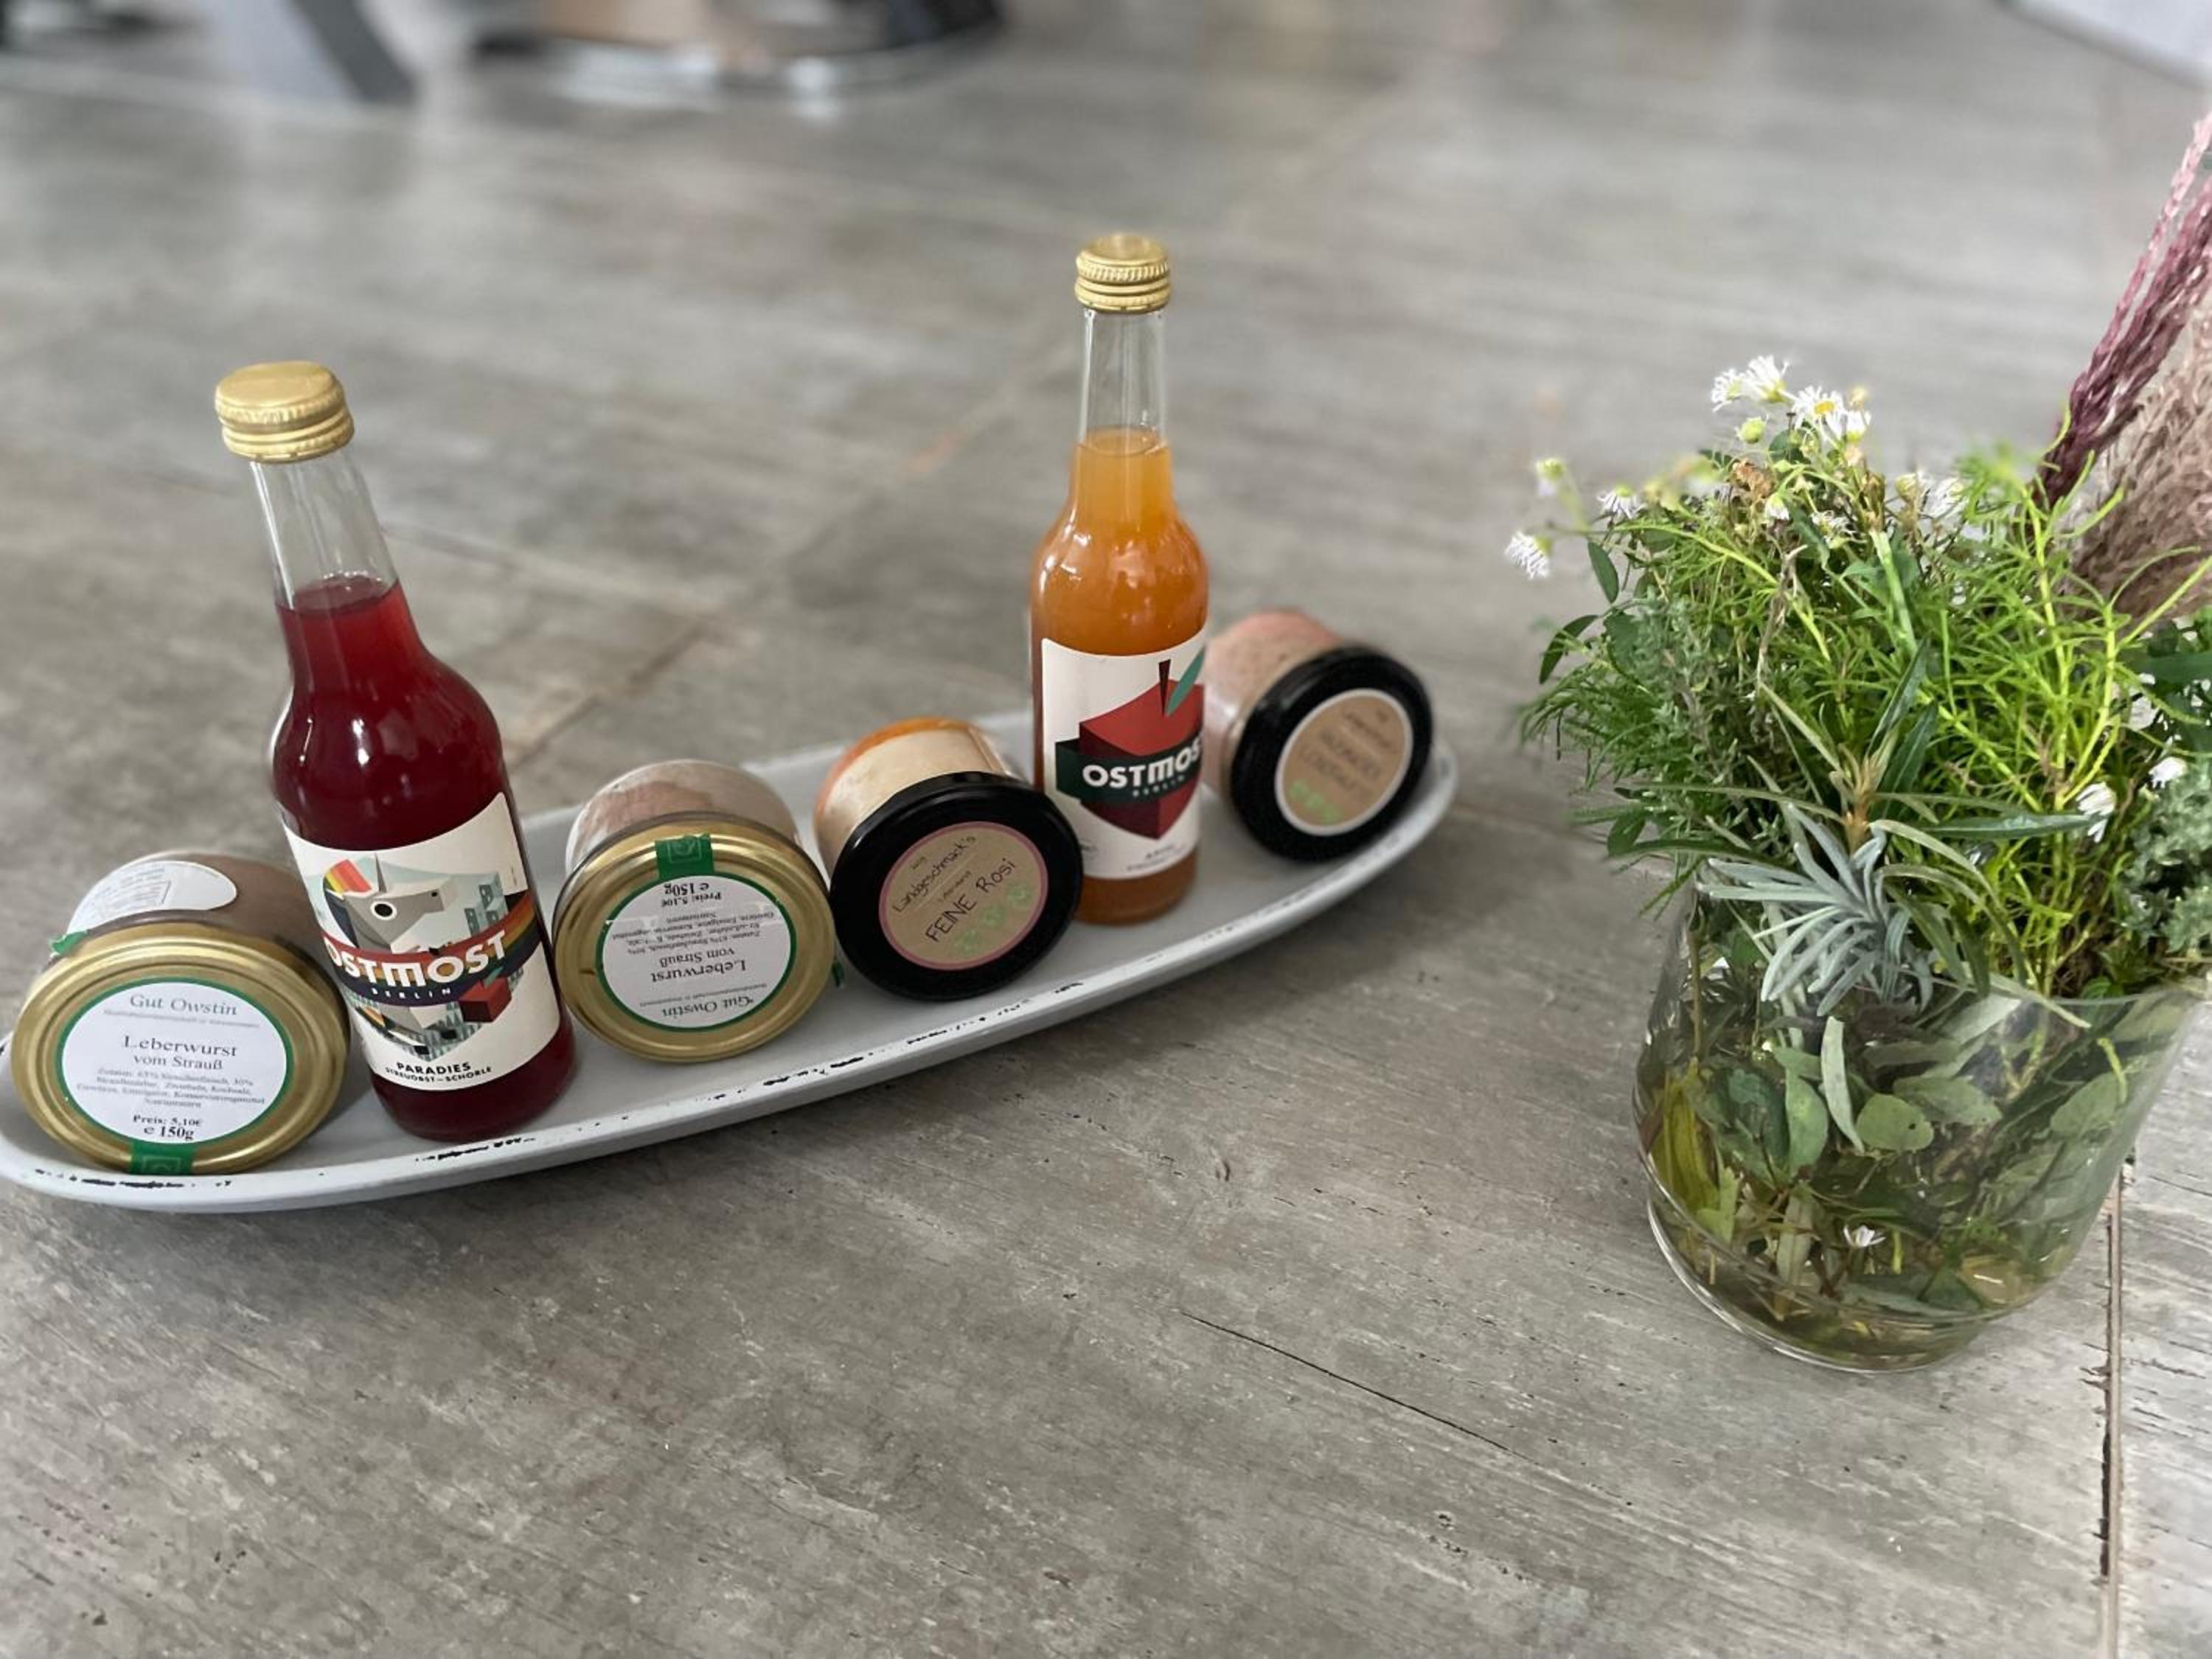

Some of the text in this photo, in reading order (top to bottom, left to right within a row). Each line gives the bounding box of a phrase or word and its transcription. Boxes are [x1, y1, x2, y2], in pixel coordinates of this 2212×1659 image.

[1082, 736, 1202, 788] OSTMOS
[664, 883, 695, 896] 150g
[692, 891, 722, 902] Preis:
[925, 894, 977, 942] FEINE
[324, 930, 506, 987] OSTMOST
[659, 948, 734, 967] vom Strauß
[651, 959, 746, 982] Leberwurst
[130, 994, 237, 1016] Gut Owstin
[662, 995, 752, 1019] Gut Owstin
[124, 1035, 237, 1057] Leberwurst
[133, 1055, 223, 1070] vom Strauß
[397, 1061, 471, 1075] PARADIES
[133, 1114, 166, 1125] Preis:
[160, 1126, 195, 1141] 150g
